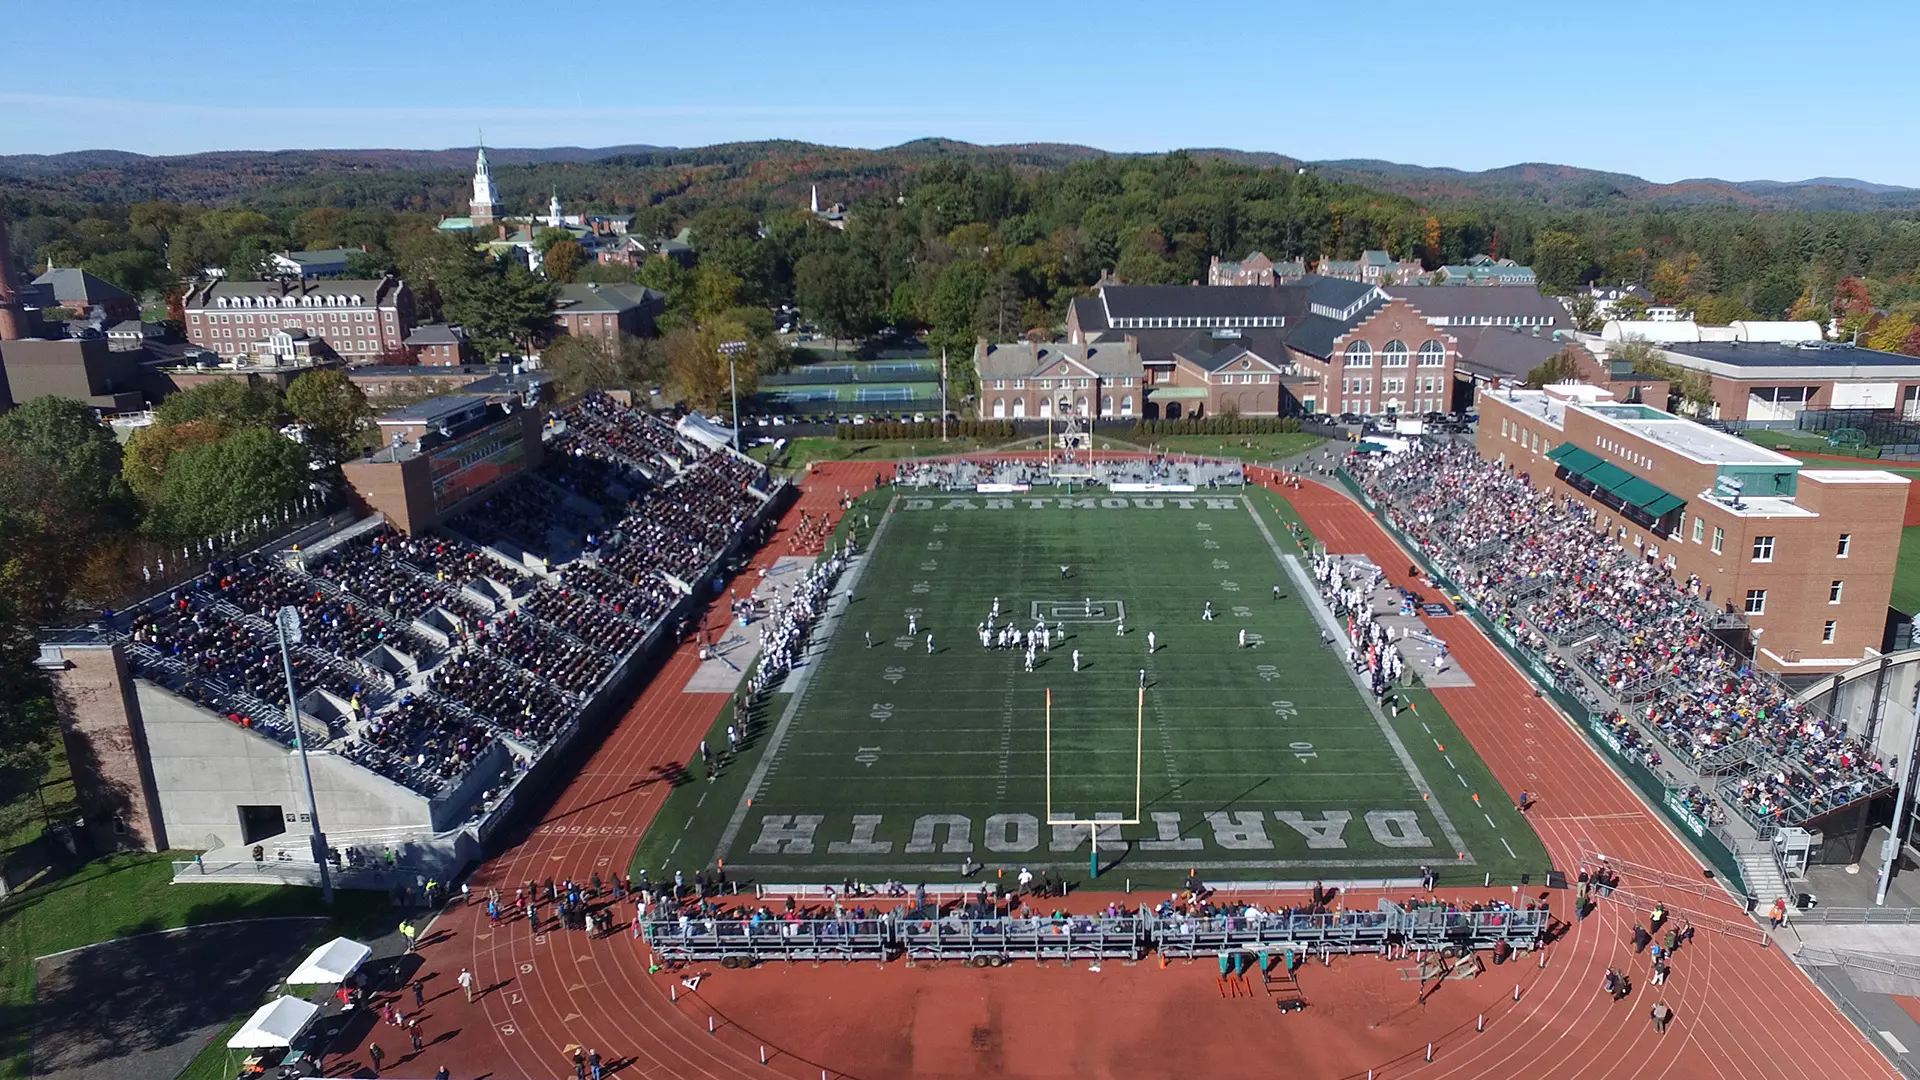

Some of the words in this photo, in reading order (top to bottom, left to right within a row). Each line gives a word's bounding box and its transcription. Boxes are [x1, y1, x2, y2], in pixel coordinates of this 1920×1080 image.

[903, 497, 1239, 510] DARTMOUTH
[882, 666, 906, 681] 30
[1256, 664, 1281, 678] 30
[869, 702, 895, 719] 20
[1271, 700, 1298, 716] 20
[855, 746, 881, 762] 10
[1289, 741, 1318, 759] 10
[748, 810, 1434, 854] DARTMOUTH
